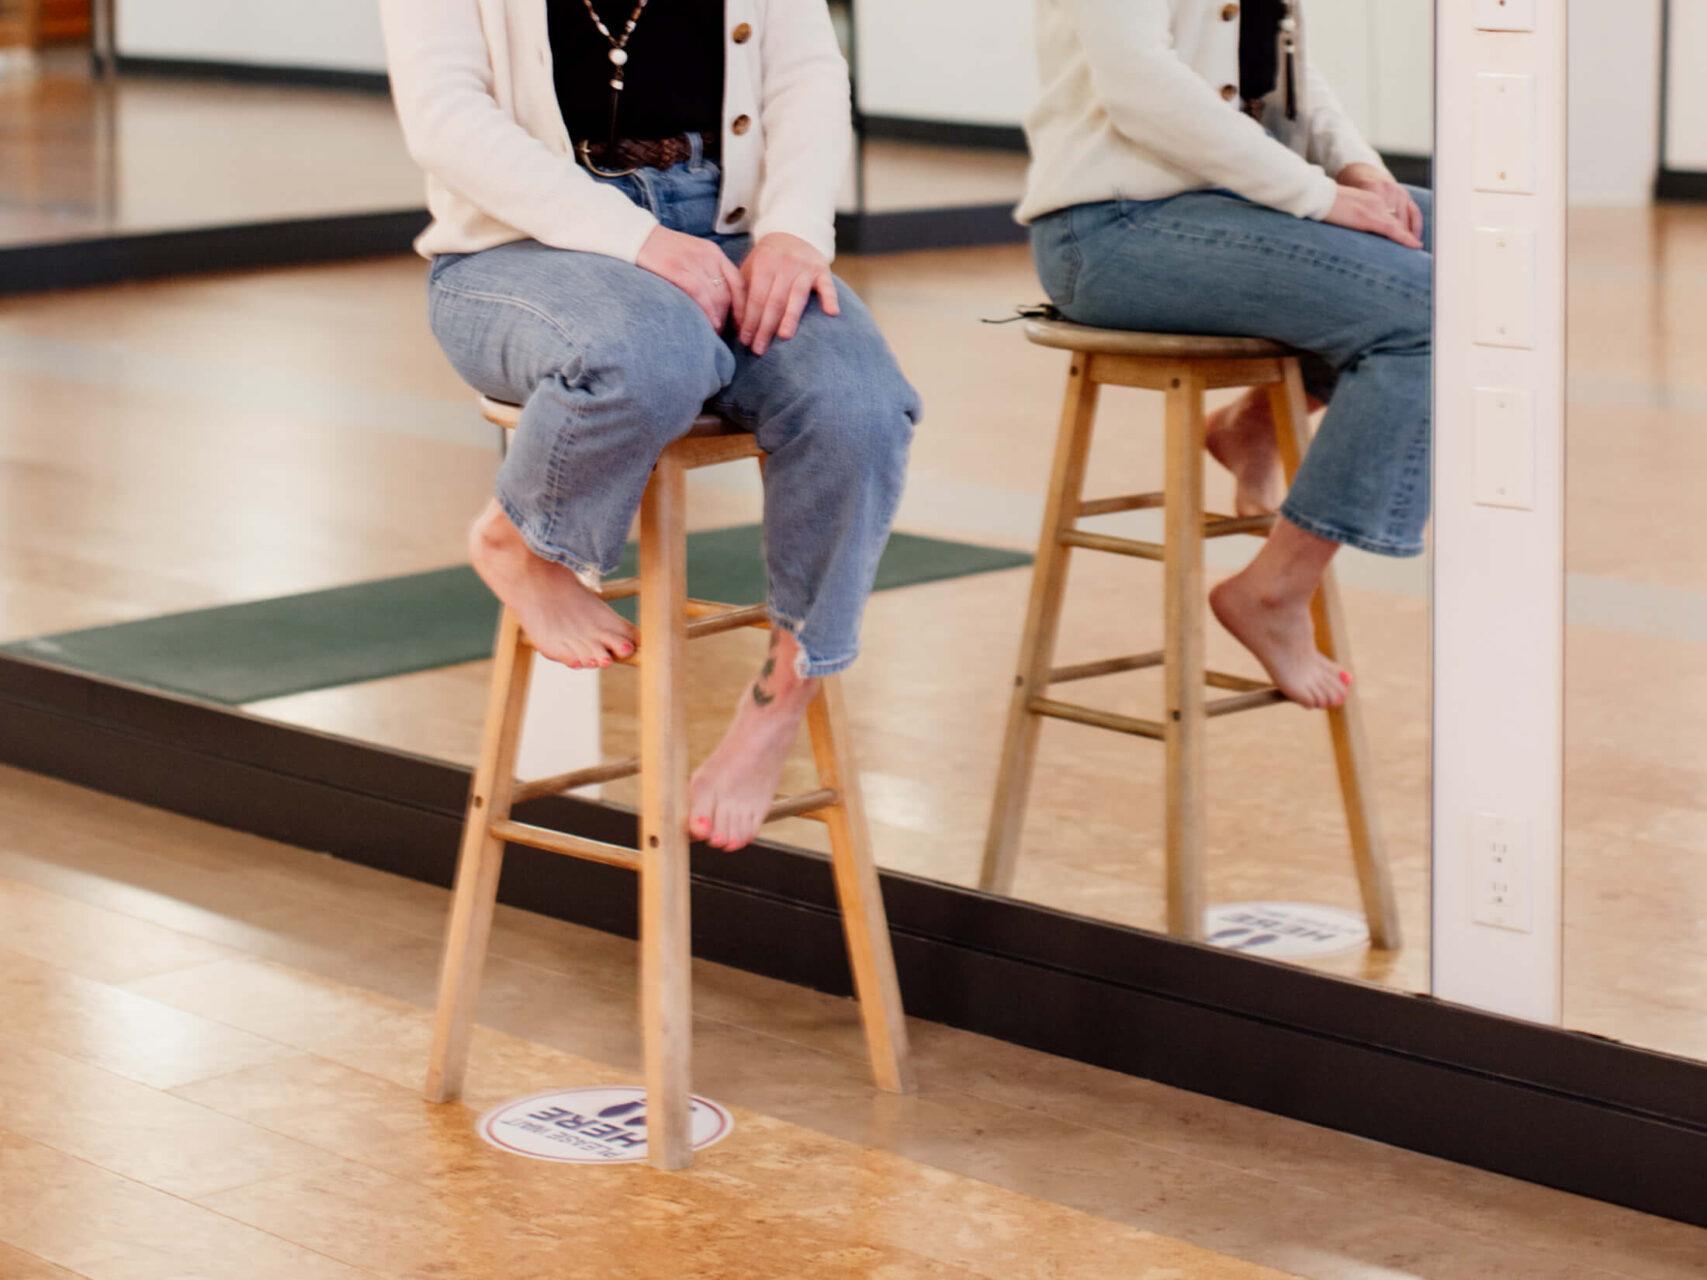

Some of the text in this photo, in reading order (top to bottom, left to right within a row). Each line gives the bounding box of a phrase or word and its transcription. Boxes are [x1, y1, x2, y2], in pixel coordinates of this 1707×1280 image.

[500, 1118, 624, 1158] PLEASE WAIT
[526, 1106, 648, 1148] HERE
